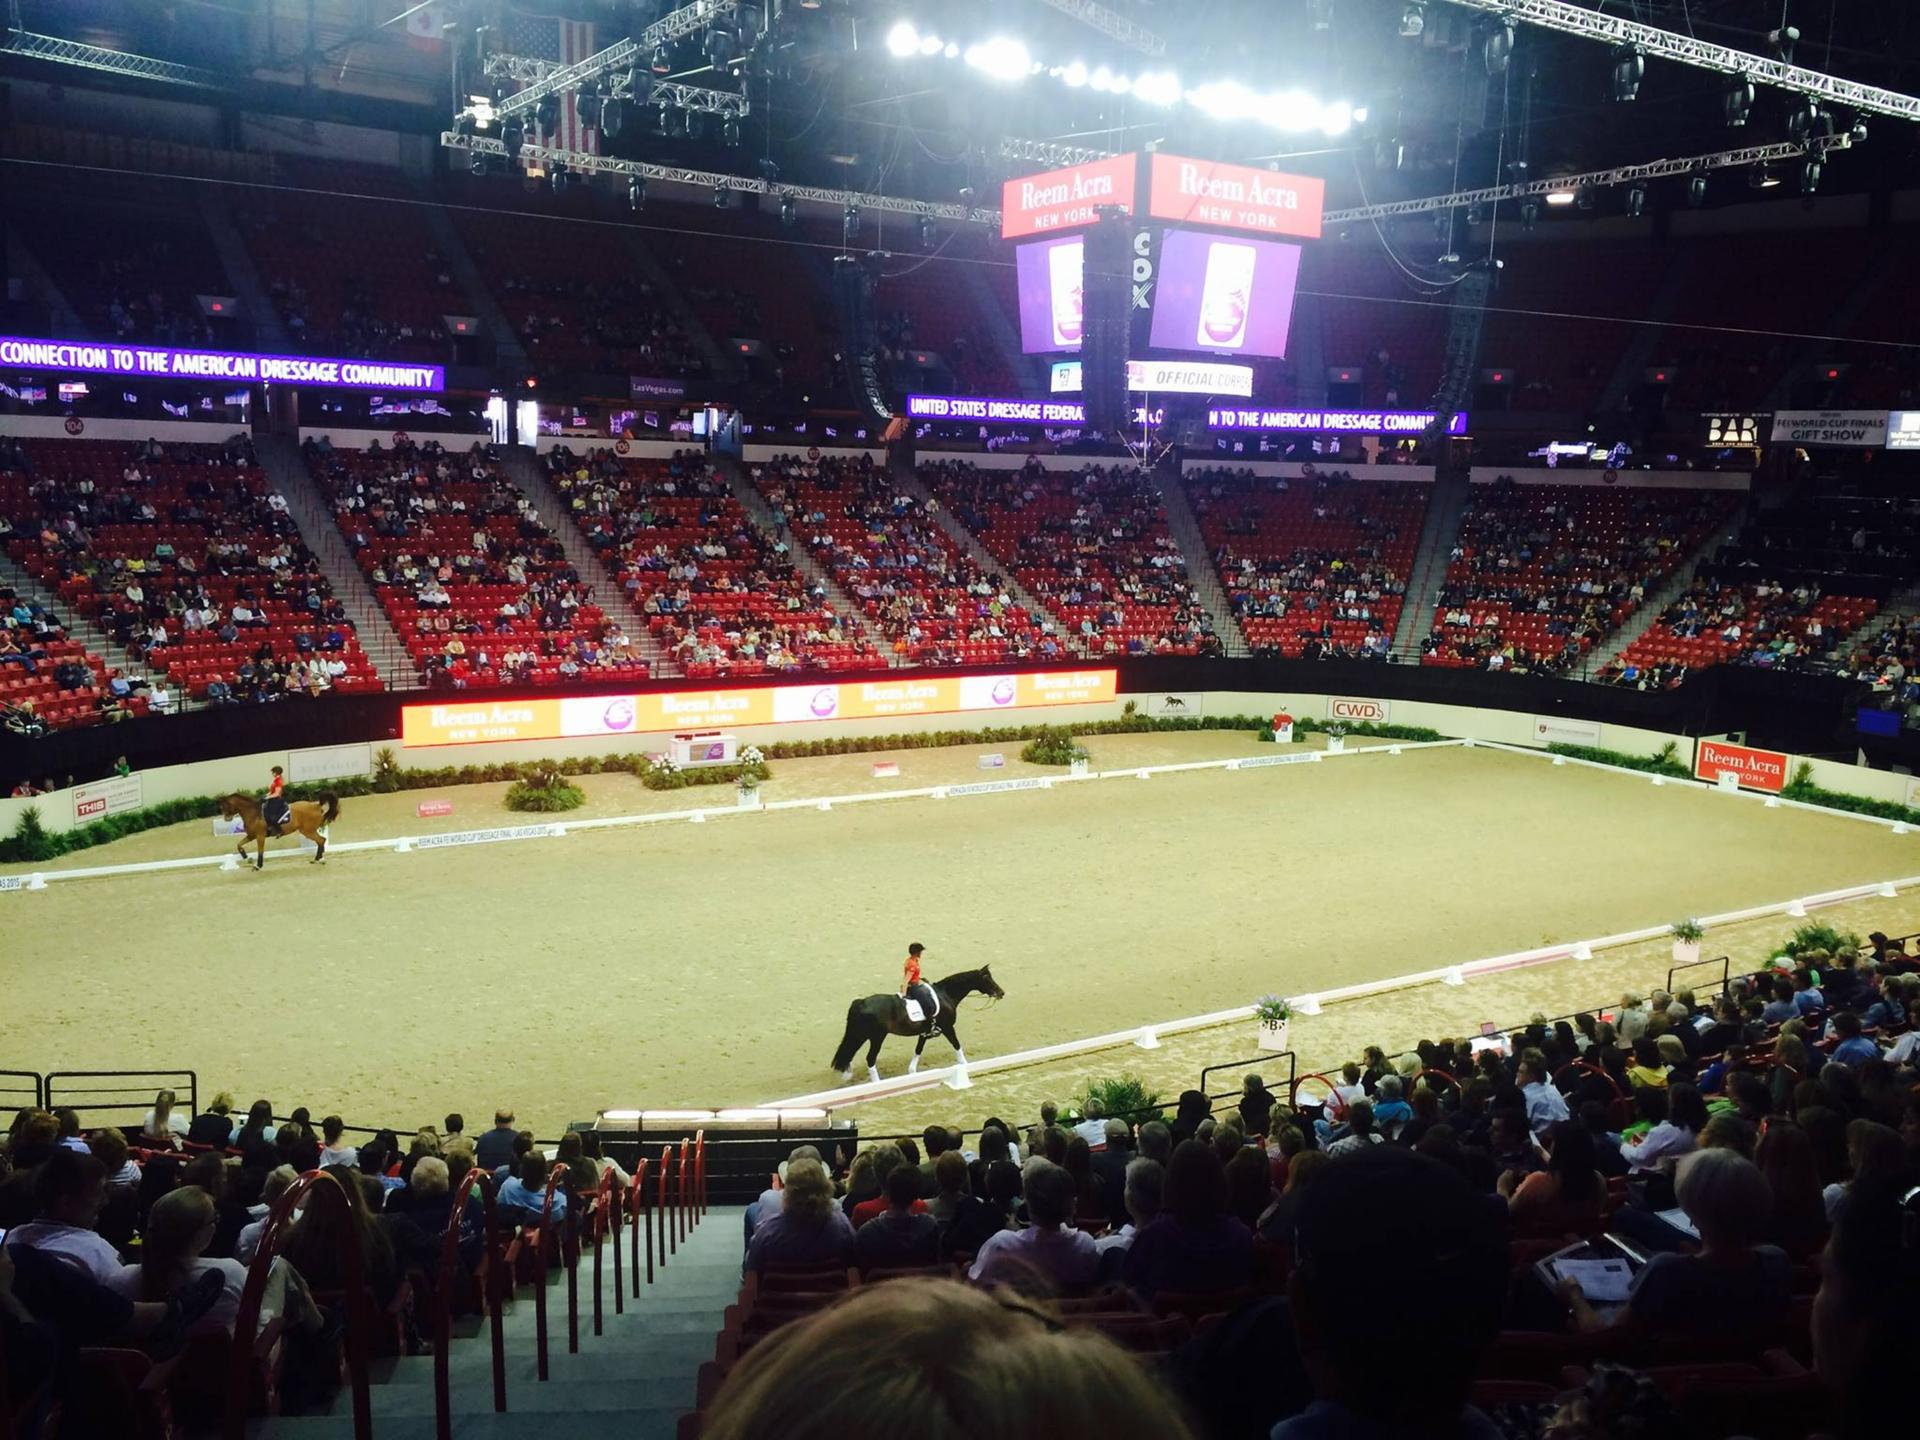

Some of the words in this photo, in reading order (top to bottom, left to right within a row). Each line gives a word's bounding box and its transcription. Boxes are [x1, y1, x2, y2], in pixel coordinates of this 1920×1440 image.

[1021, 180, 1069, 211] Reem
[1071, 171, 1112, 200] Acra
[1179, 162, 1244, 203] Reem
[1249, 175, 1298, 210] Acra
[1035, 211, 1059, 228] NEW
[1063, 207, 1094, 223] YORK
[1200, 206, 1232, 222] NEW
[1238, 211, 1278, 228] YORK
[1132, 232, 1154, 311] COX
[0, 342, 107, 369] CONNECTION
[110, 350, 134, 370] TO
[136, 351, 169, 373] THE
[172, 354, 256, 378] AMERICAN
[259, 359, 339, 382] DRESSAGE
[341, 365, 434, 388] COMMUNITY
[1156, 370, 1213, 386] OFFICIAL
[633, 383, 684, 395] LasVegas.com
[910, 398, 949, 416] UNITED
[950, 400, 987, 418] STATES
[988, 402, 1041, 420] DRESSAGE
[1221, 411, 1235, 426] TO
[1238, 411, 1261, 427] THE
[1261, 413, 1321, 429] AMERICAN
[1323, 414, 1382, 430] DRESSAGE
[1709, 418, 1759, 443] BAR!
[1791, 419, 1828, 429] WORLD
[1828, 419, 1849, 428] CUP
[1850, 419, 1885, 428] FINALS
[1791, 430, 1821, 441] GIFT
[1822, 430, 1866, 441] SHOW
[662, 695, 710, 714] Reem
[712, 693, 749, 711] Acra
[1335, 703, 1376, 717] CWD
[431, 707, 486, 727] Reem
[490, 705, 534, 723] Acra
[449, 729, 477, 739] NEW
[481, 727, 518, 737] YORK
[1704, 747, 1744, 769] Reem
[1746, 755, 1780, 775] Acra
[1740, 772, 1766, 783] YORK
[79, 800, 105, 815] THIS
[1270, 1020, 1278, 1030] B
